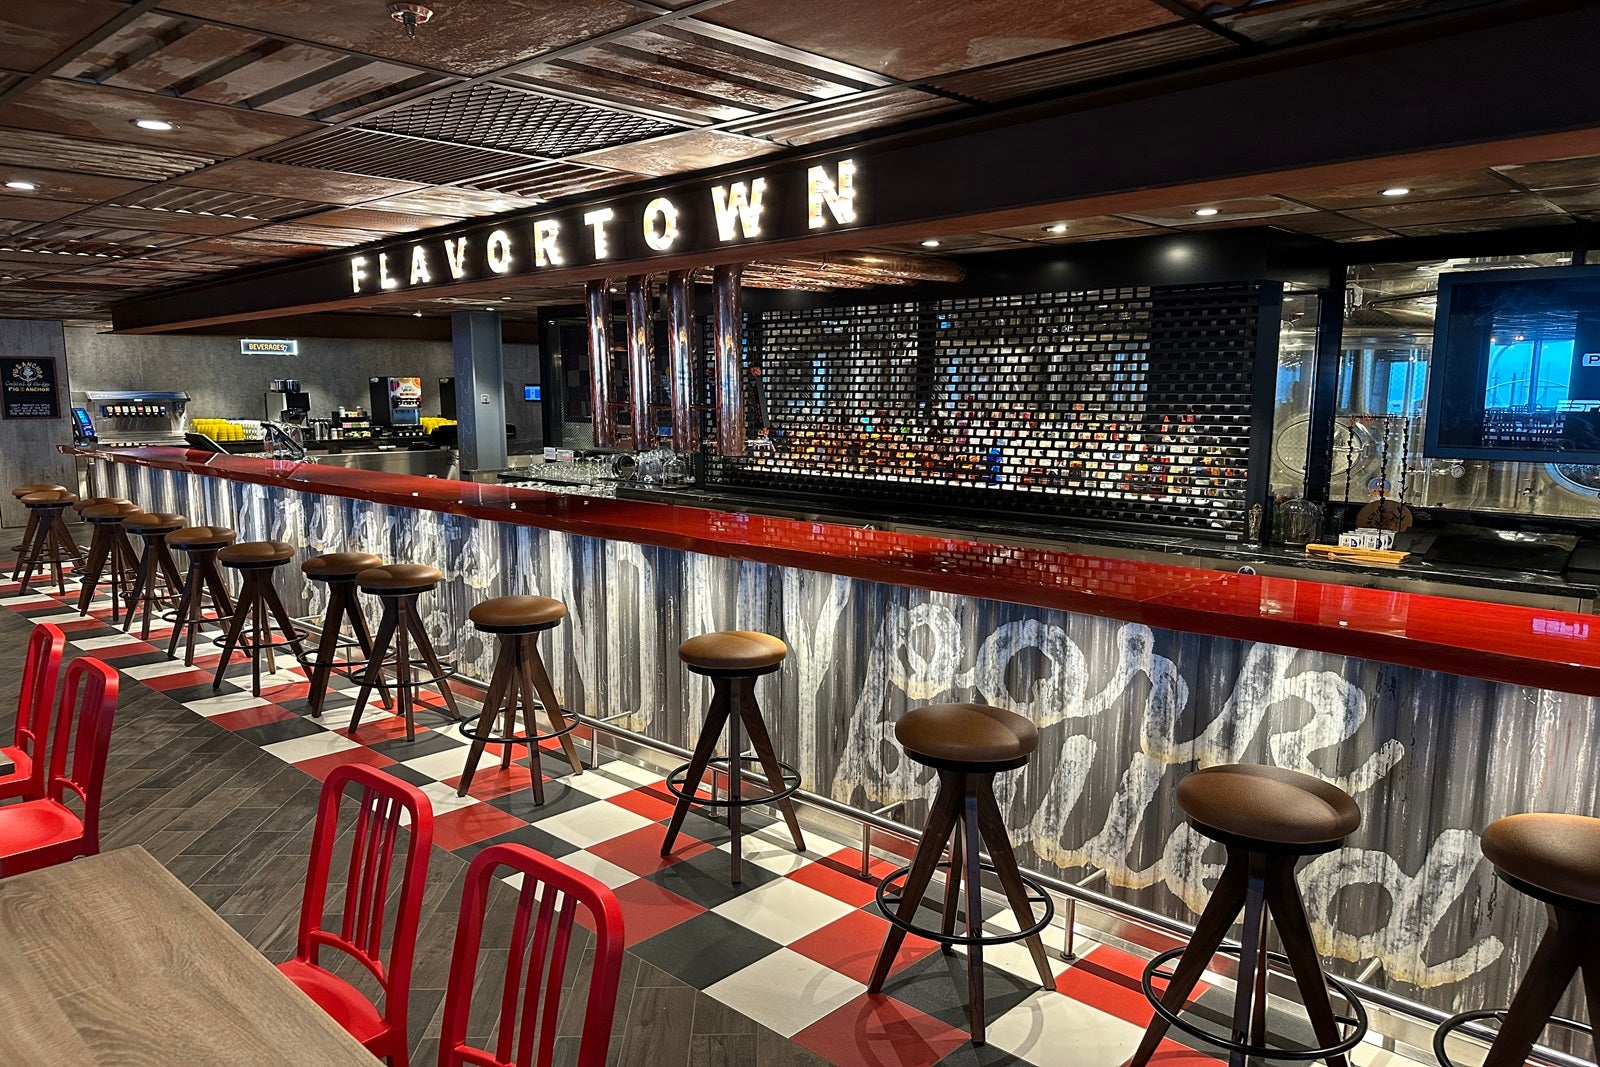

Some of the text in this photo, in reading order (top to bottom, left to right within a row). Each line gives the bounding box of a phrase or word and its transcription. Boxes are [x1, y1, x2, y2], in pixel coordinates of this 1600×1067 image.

[351, 158, 857, 293] FLAVORTOWN
[249, 343, 284, 351] BEVERAGES
[1556, 400, 1600, 413] ESP
